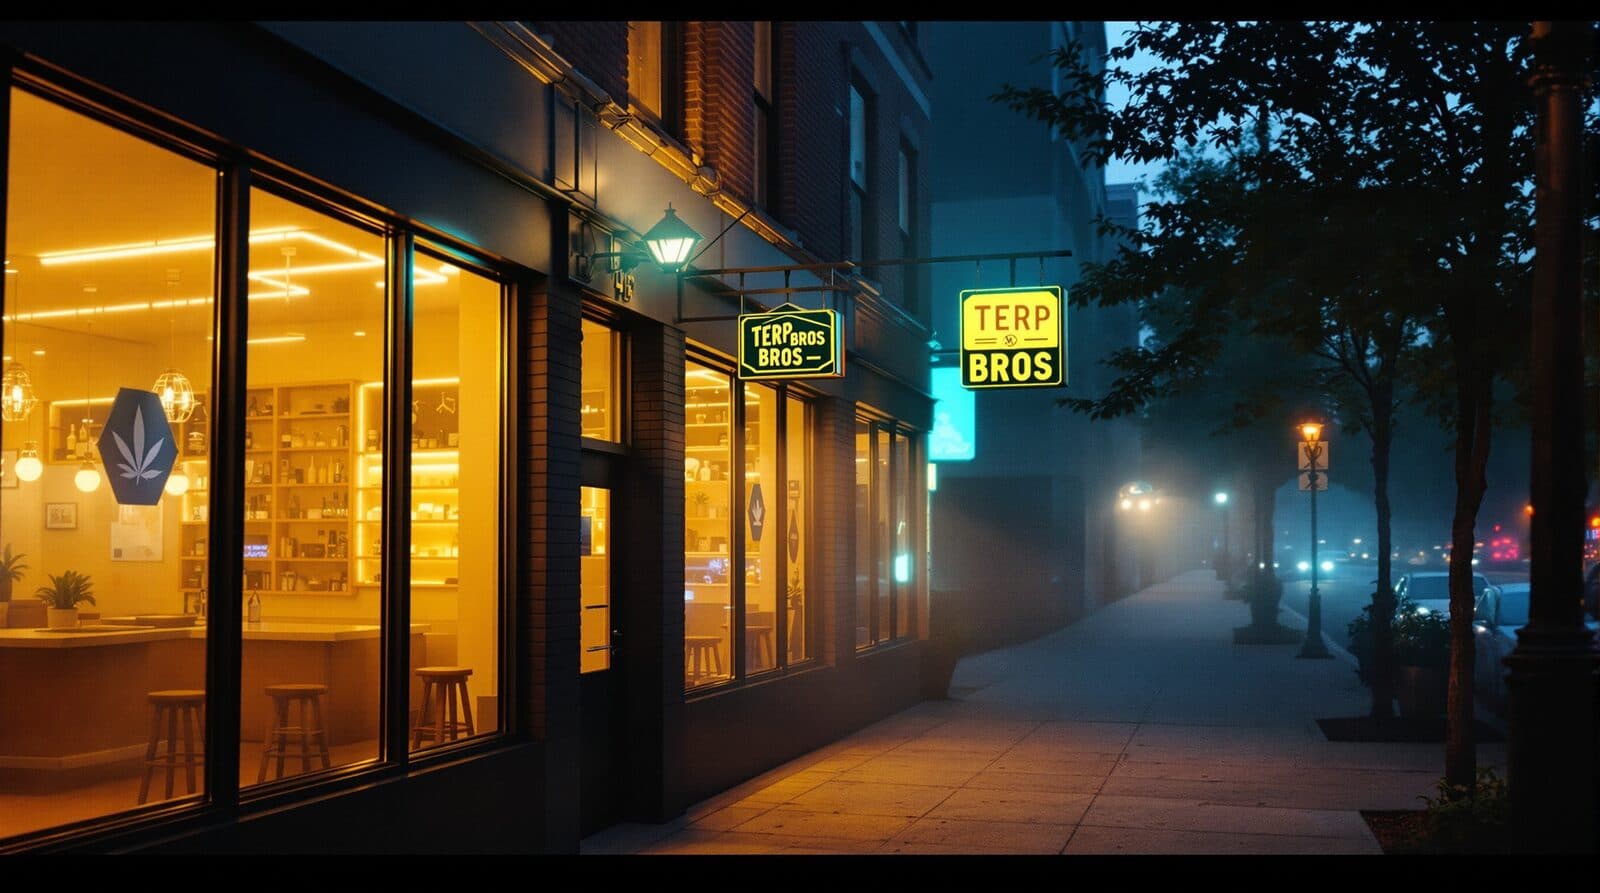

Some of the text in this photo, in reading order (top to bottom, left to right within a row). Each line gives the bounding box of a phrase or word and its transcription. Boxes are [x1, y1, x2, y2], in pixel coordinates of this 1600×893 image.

[974, 304, 1051, 331] TERP
[751, 321, 826, 348] TERP BROS
[758, 347, 803, 367] BROS
[969, 351, 1053, 383] BROS
